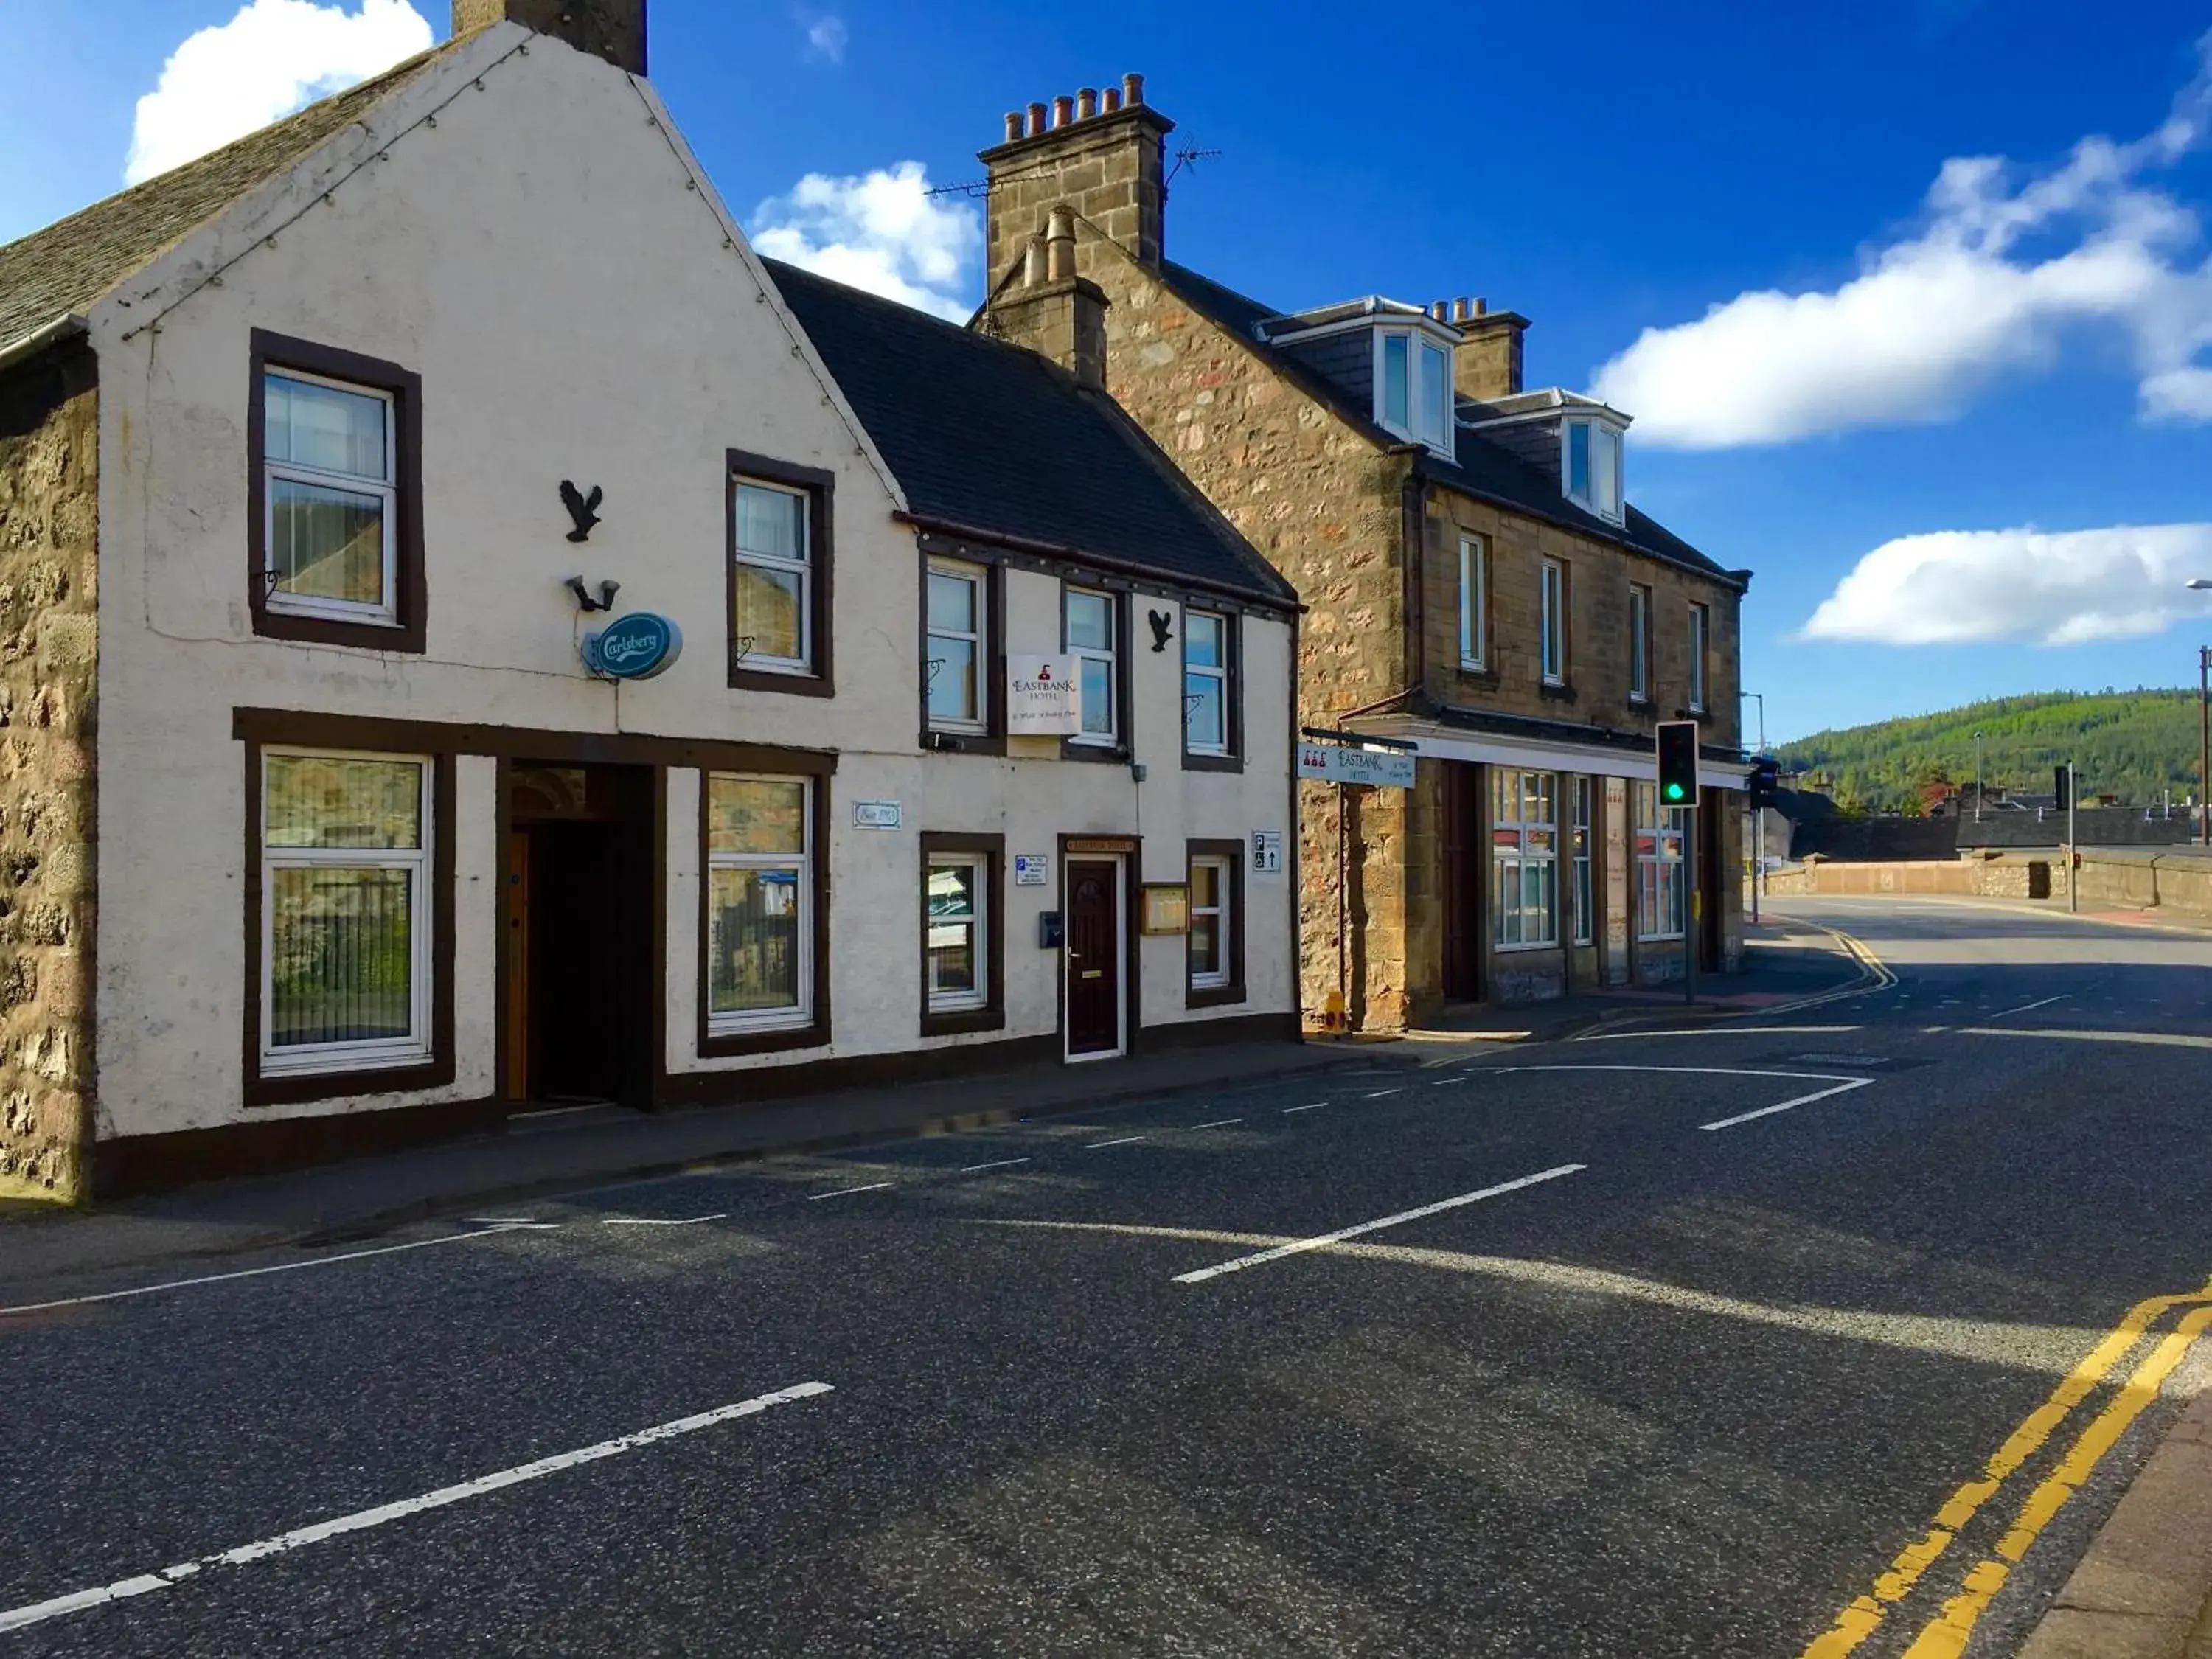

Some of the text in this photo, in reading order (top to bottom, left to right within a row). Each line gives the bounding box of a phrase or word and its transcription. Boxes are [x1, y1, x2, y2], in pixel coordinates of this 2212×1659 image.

[604, 634, 657, 661] Carlsberg
[1012, 680, 1076, 692] EASTBANK
[1338, 750, 1382, 771] EASTBANK
